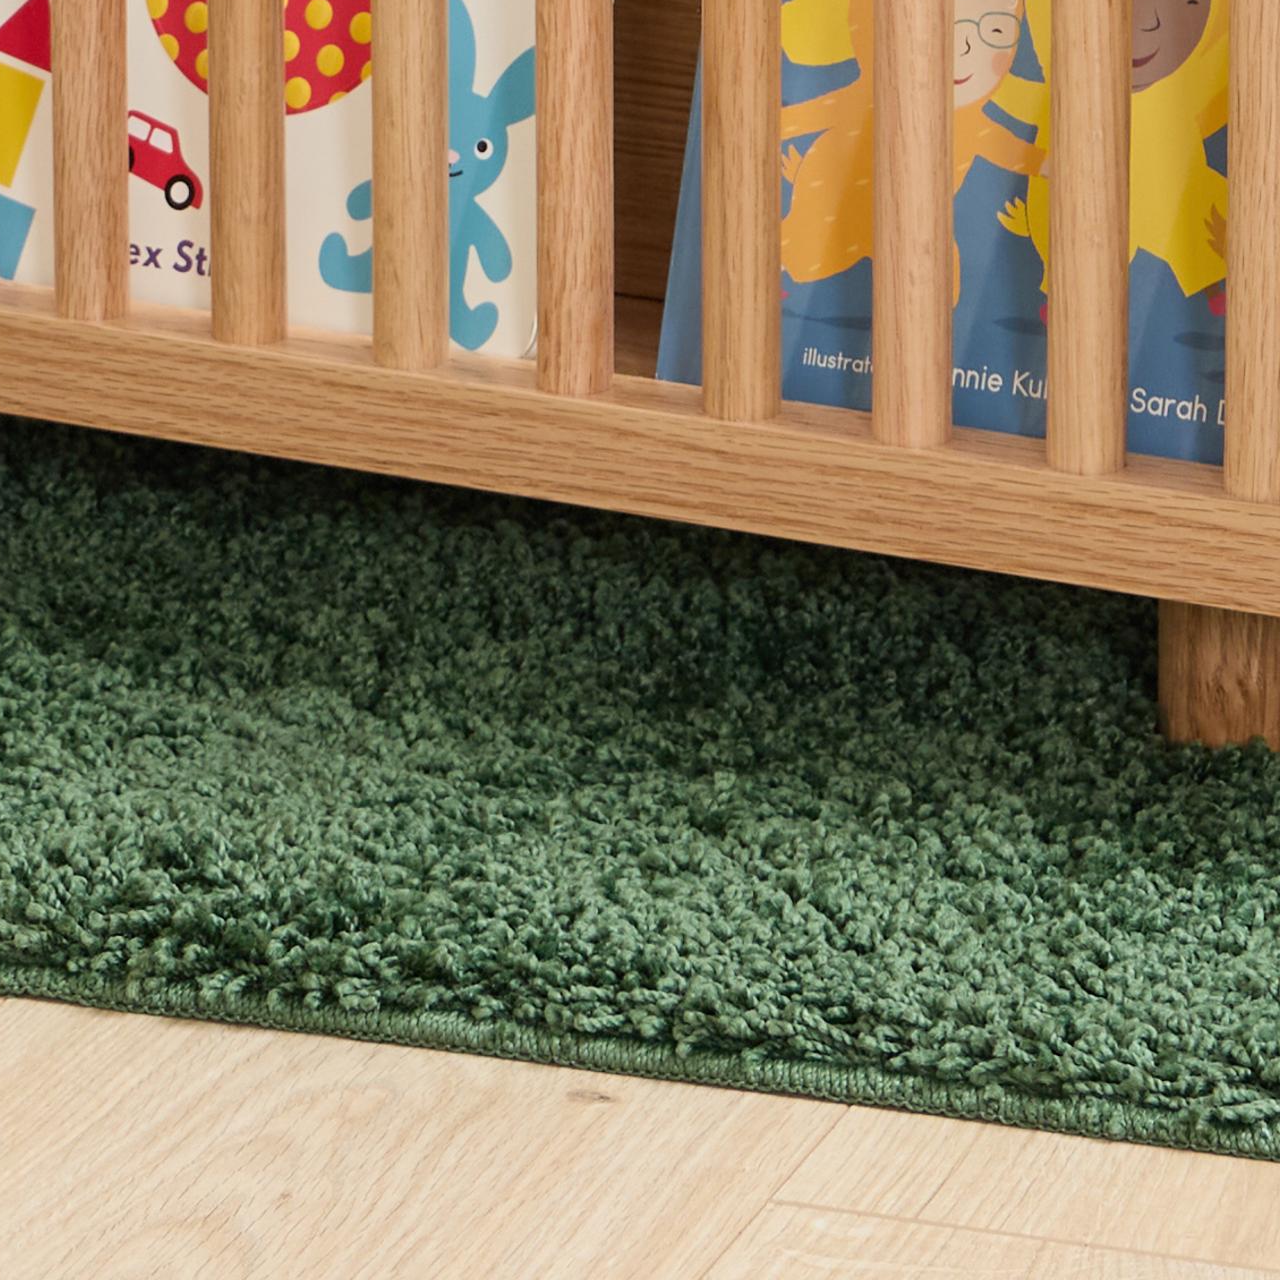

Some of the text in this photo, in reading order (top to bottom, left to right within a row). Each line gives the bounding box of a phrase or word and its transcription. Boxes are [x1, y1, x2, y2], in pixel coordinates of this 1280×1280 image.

[801, 346, 874, 376] illustrat
[951, 365, 1003, 393] nnie
[1129, 386, 1207, 424] Sarah
